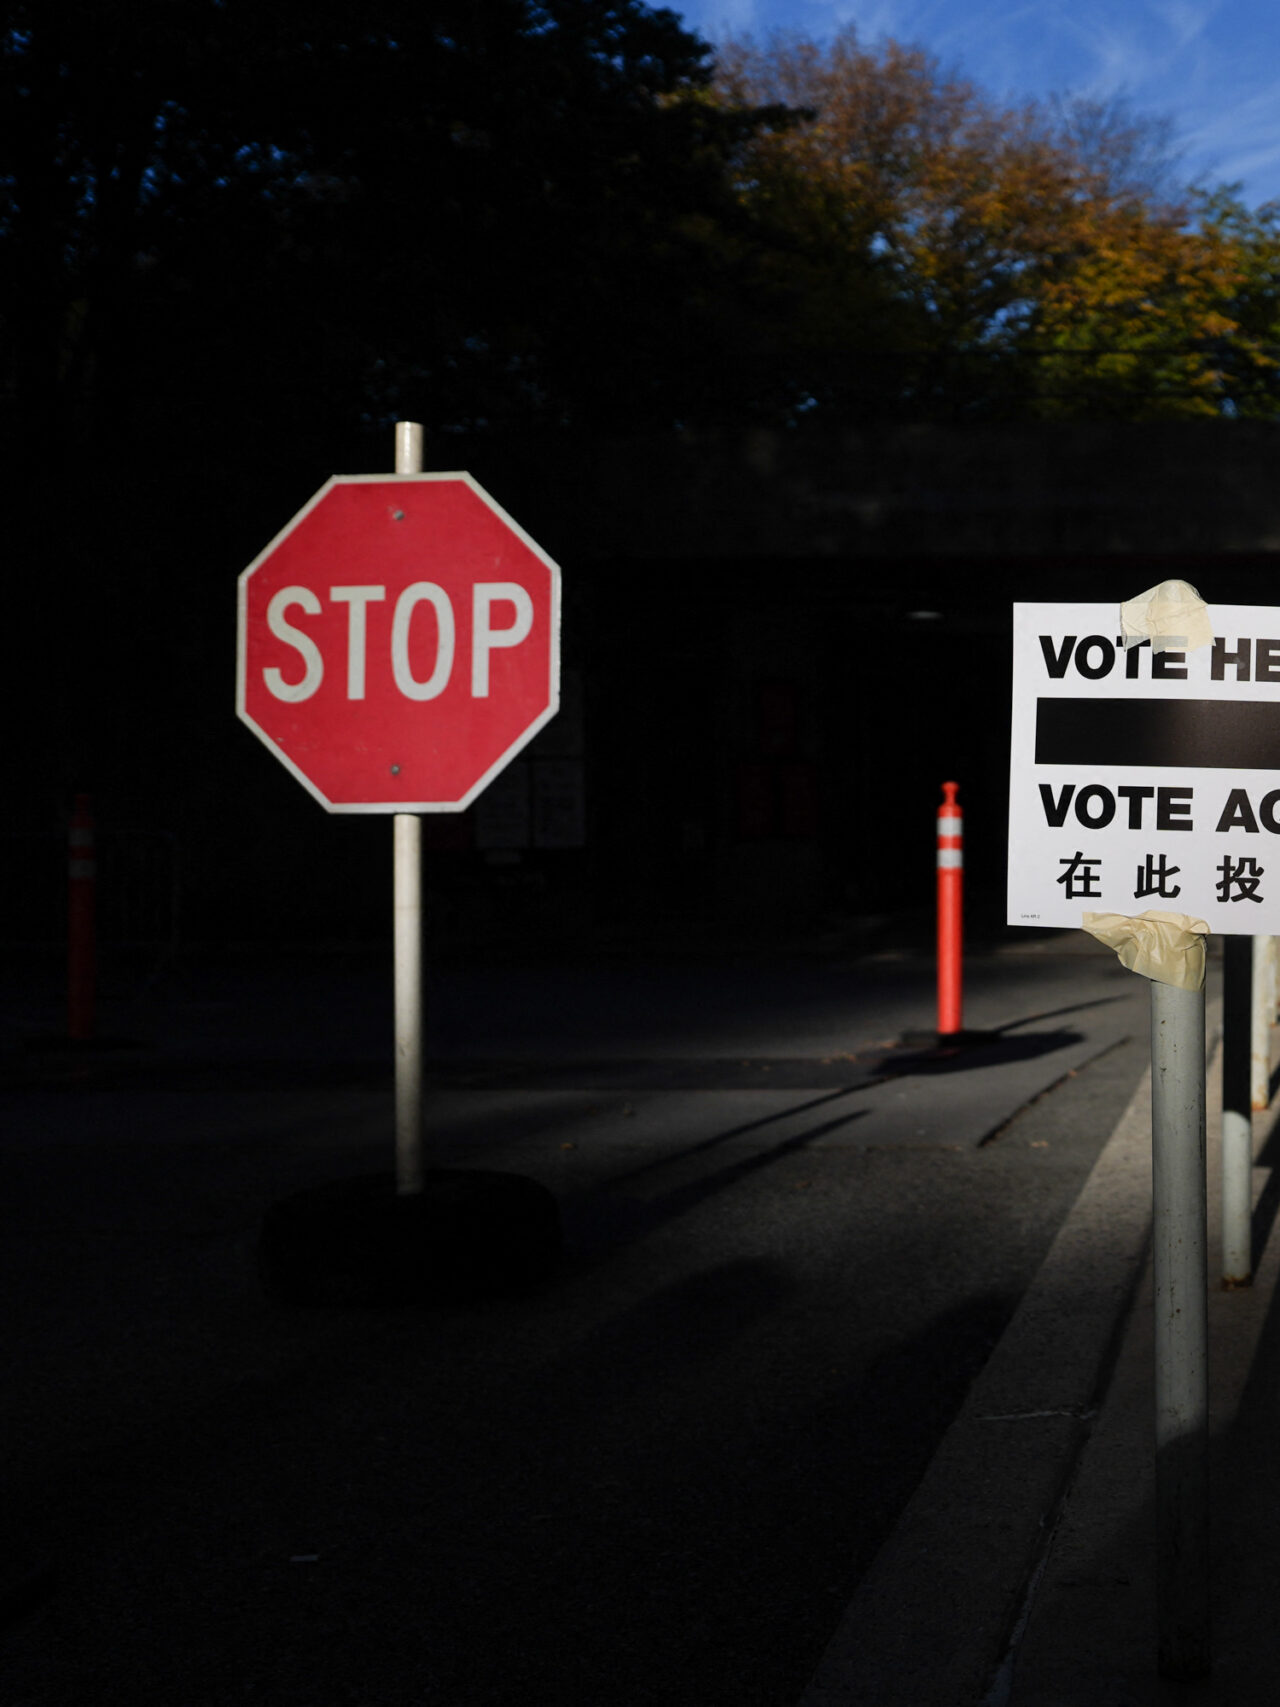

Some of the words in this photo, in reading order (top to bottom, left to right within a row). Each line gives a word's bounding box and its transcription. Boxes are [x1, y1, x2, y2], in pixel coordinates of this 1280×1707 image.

[263, 581, 534, 703] STOP
[1039, 635, 1188, 680] VOTE
[1038, 784, 1194, 832] VOTE
